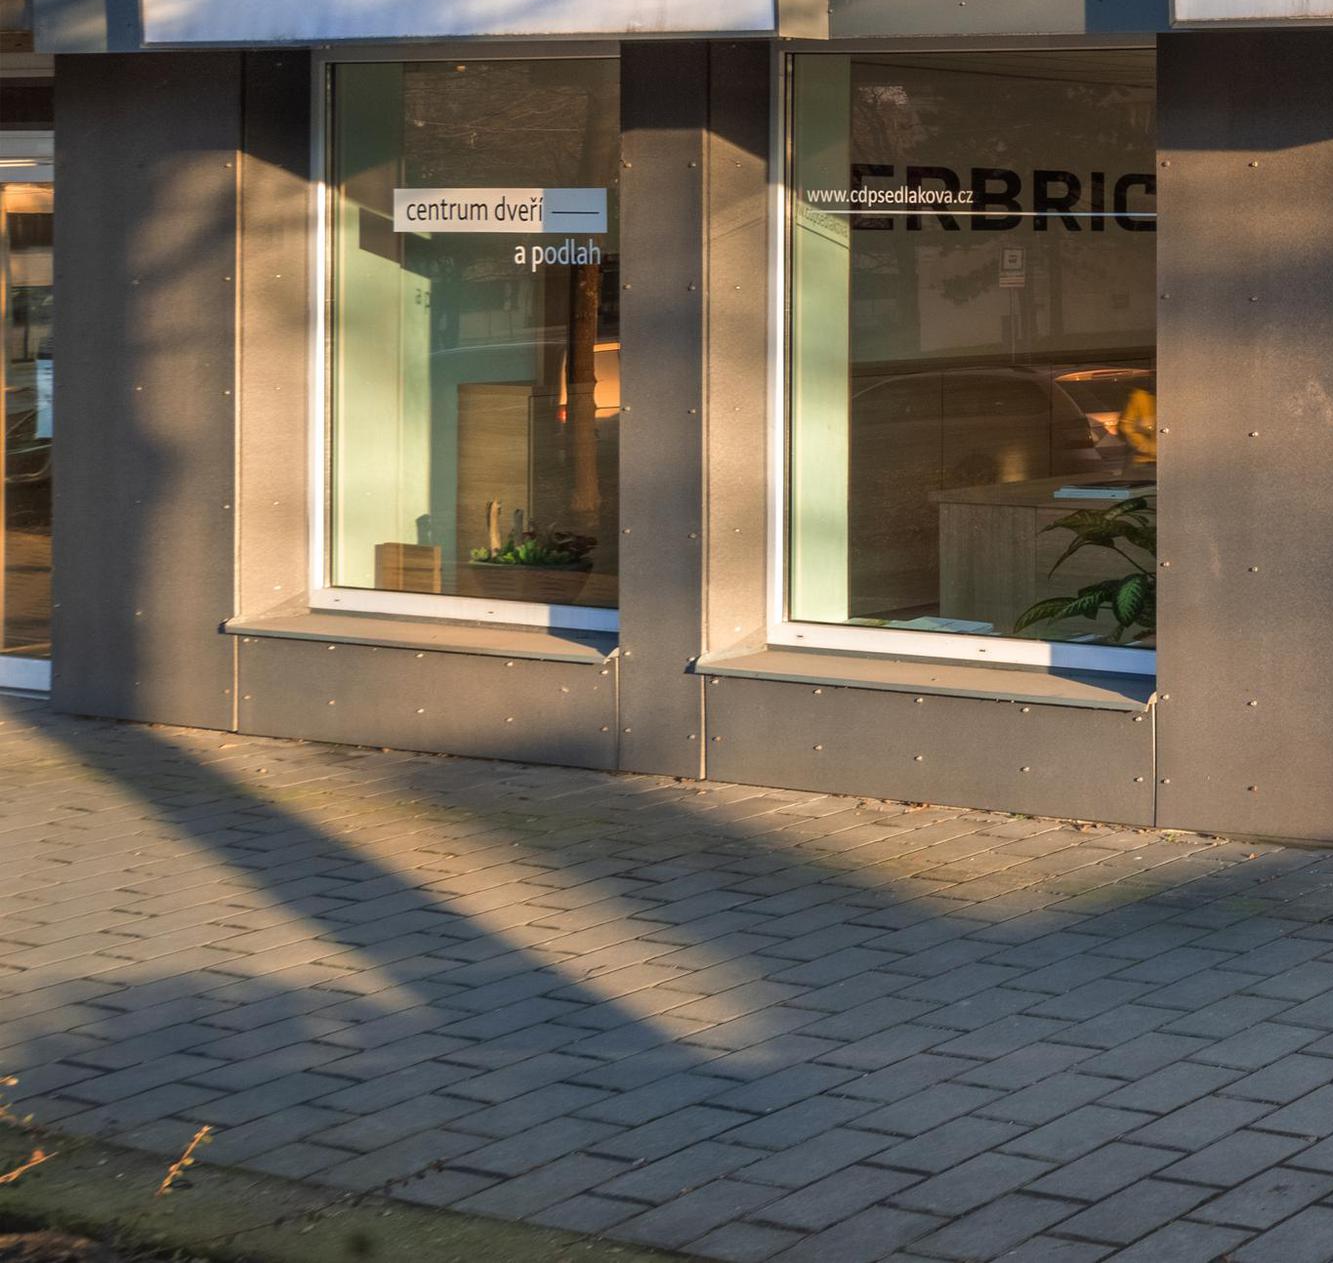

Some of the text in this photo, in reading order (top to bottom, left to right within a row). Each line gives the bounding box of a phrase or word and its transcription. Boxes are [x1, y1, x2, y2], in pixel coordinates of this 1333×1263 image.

[406, 195, 544, 222] centrum dveří
[807, 185, 974, 207] www.cdpsedlakova.cz
[514, 238, 601, 273] a podlah
